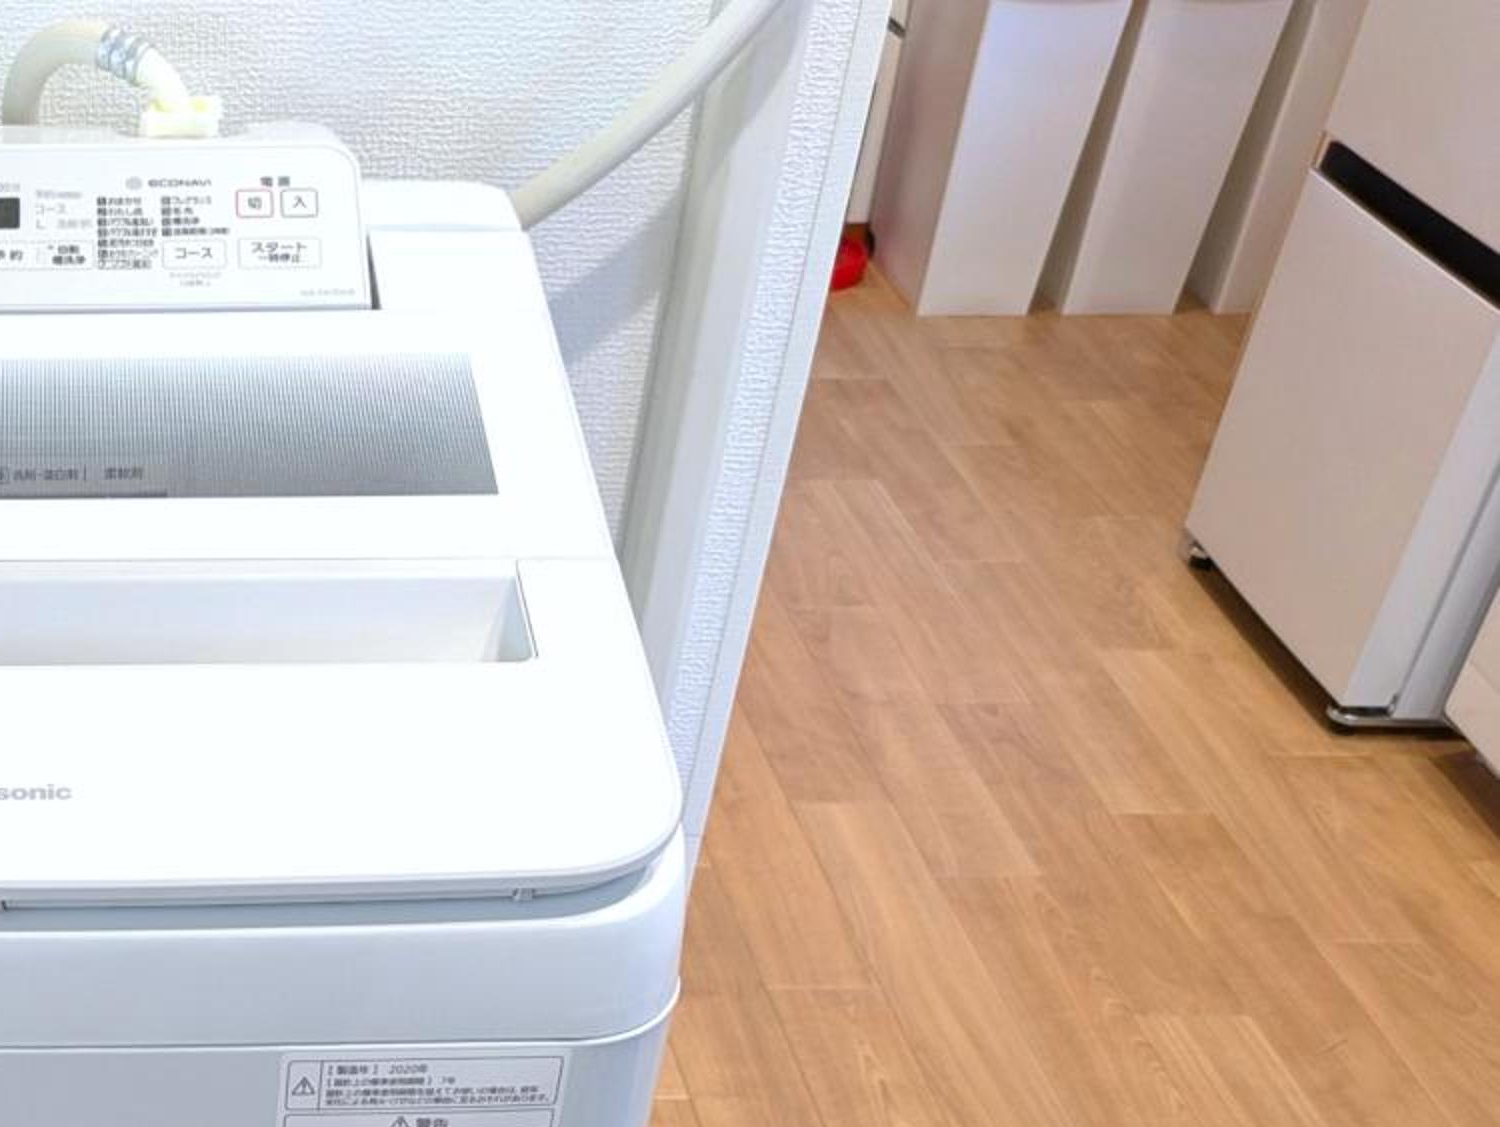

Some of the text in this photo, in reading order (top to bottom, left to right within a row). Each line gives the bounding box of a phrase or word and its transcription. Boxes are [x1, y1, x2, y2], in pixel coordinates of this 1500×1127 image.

[259, 176, 290, 187] 電源
[247, 197, 262, 209] 切
[293, 195, 307, 208] 入
[57, 245, 80, 254] 自動
[251, 242, 308, 252] スタート
[174, 247, 213, 259] コース
[258, 254, 302, 263] 一時停止
